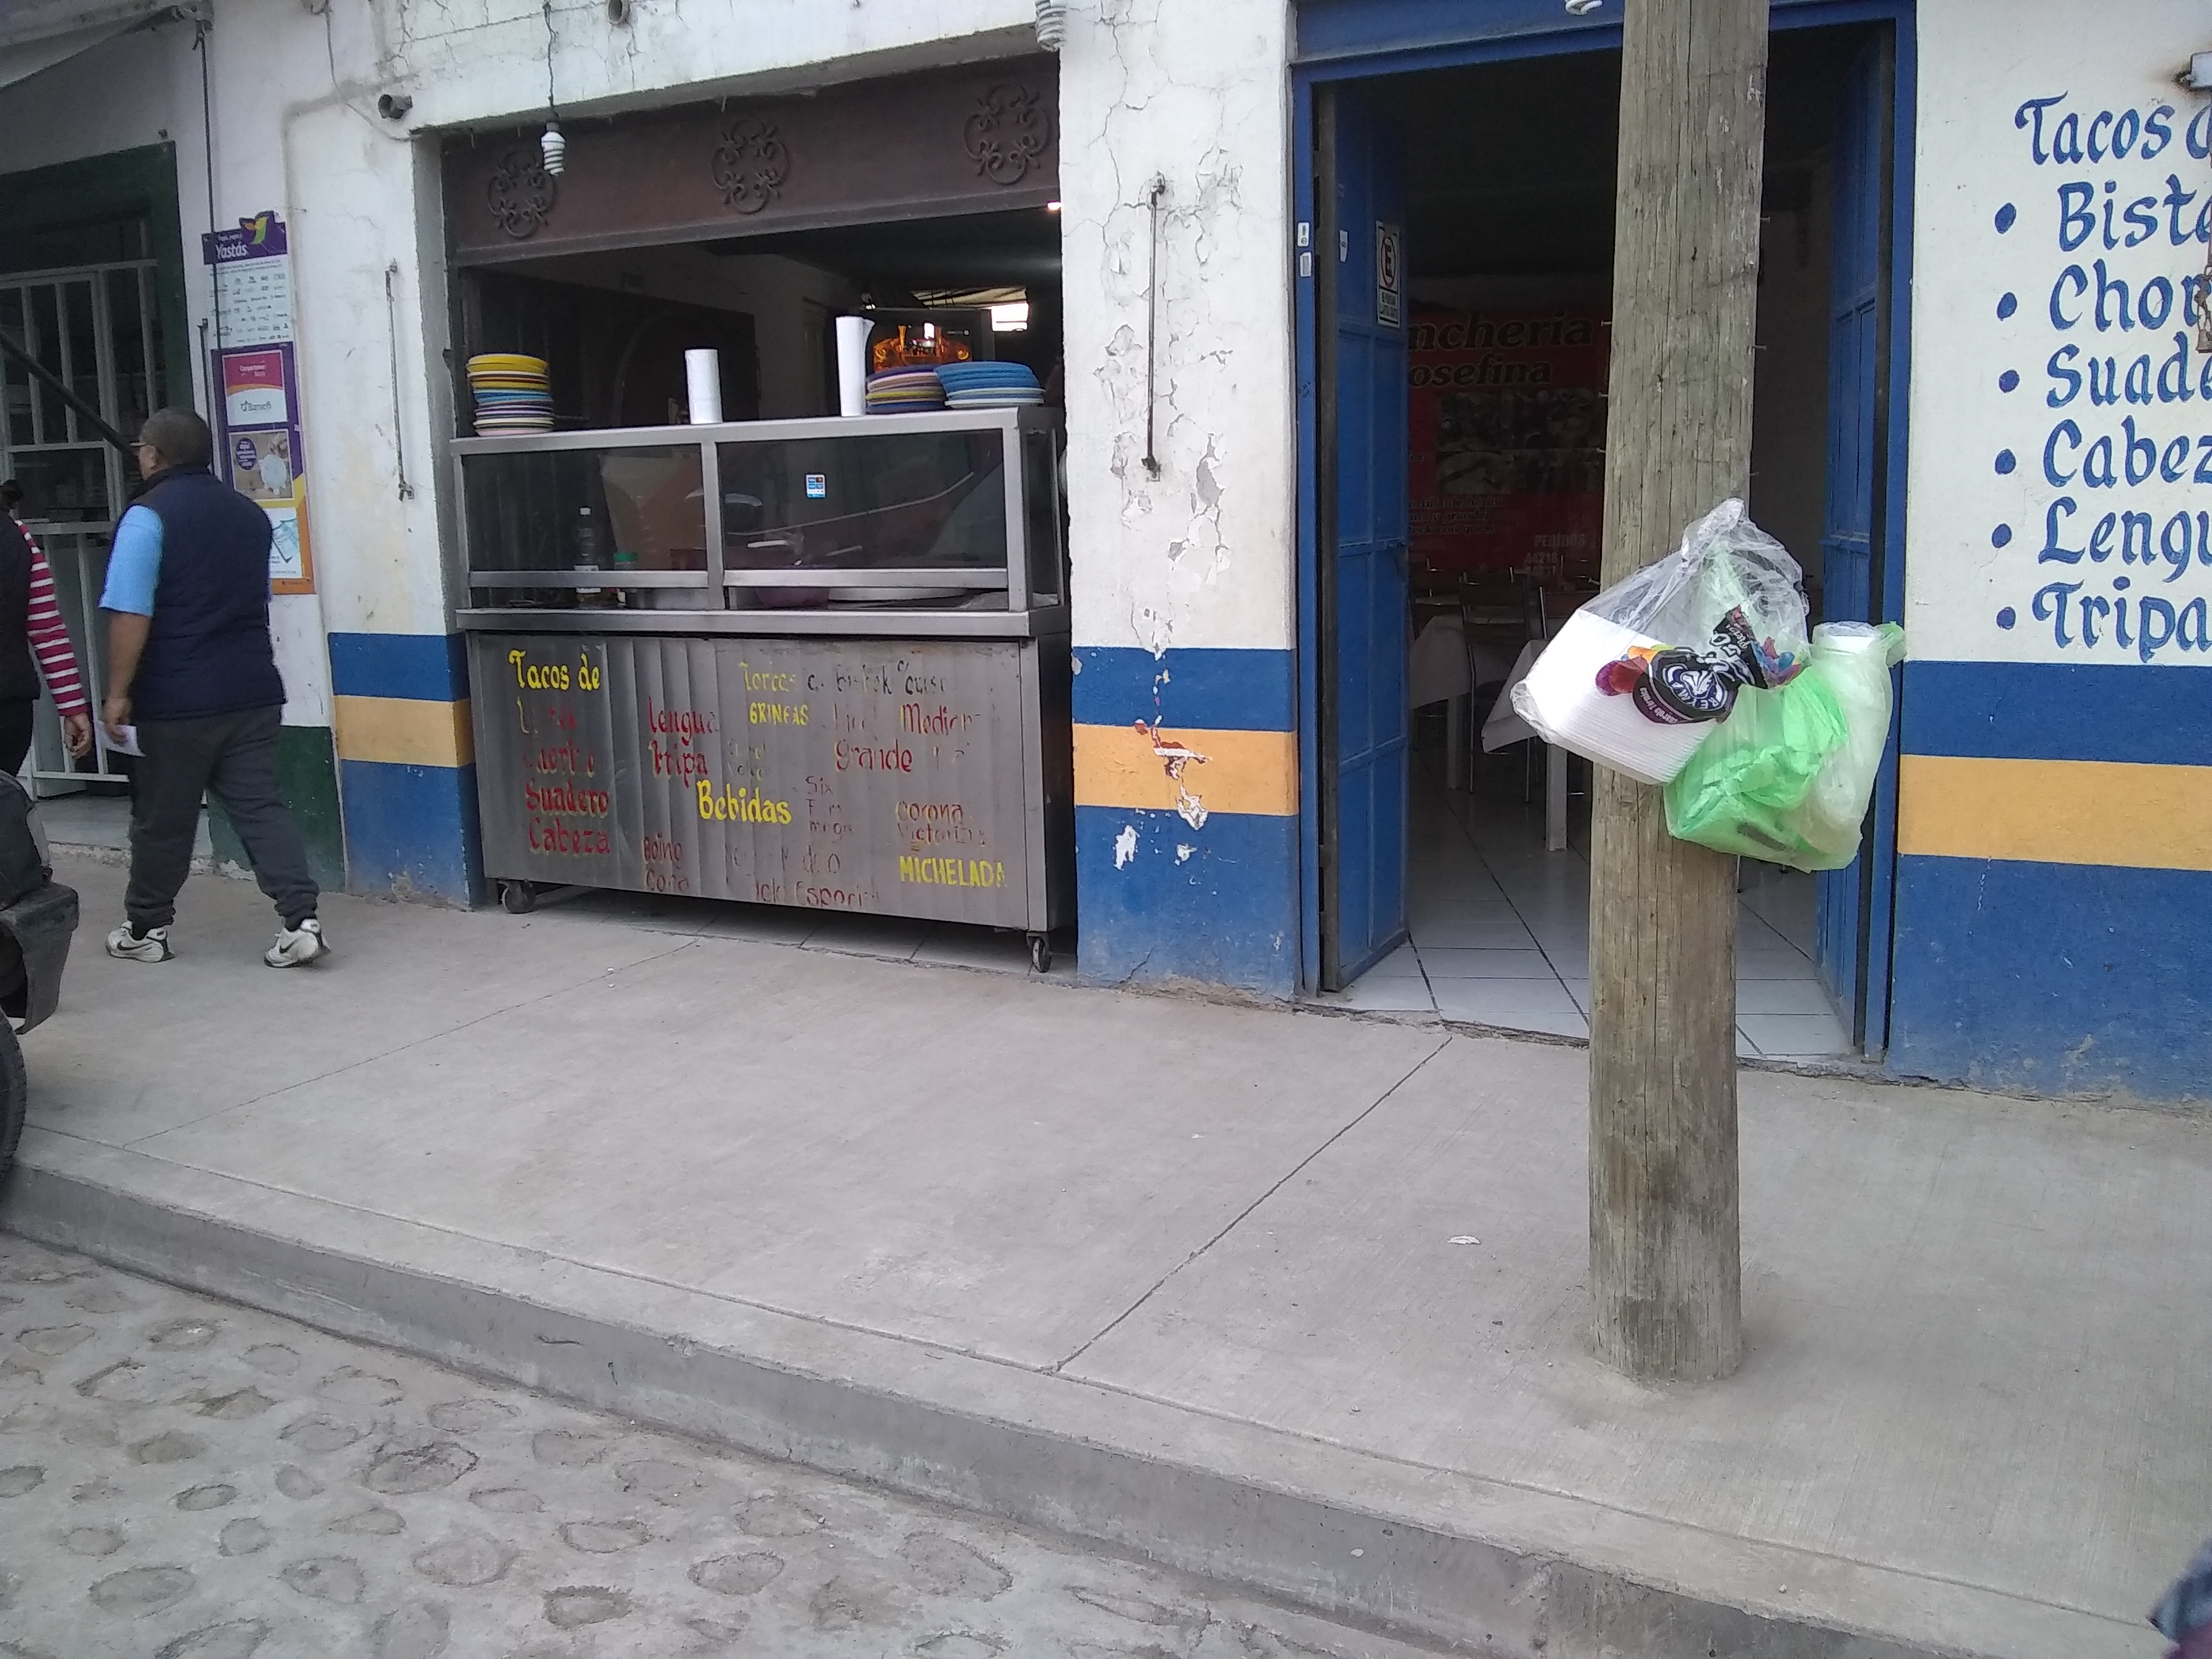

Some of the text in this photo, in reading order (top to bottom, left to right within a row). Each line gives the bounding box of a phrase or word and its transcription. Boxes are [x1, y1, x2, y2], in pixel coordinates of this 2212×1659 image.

[2014, 90, 2175, 165] Tacos
[215, 241, 249, 260] Yastás
[2043, 414, 2212, 489] Cabez
[2032, 577, 2212, 664] Tripa
[508, 649, 601, 691] Tacos de
[1668, 679, 1717, 710] REYMA
[696, 779, 793, 825] Bebidas
